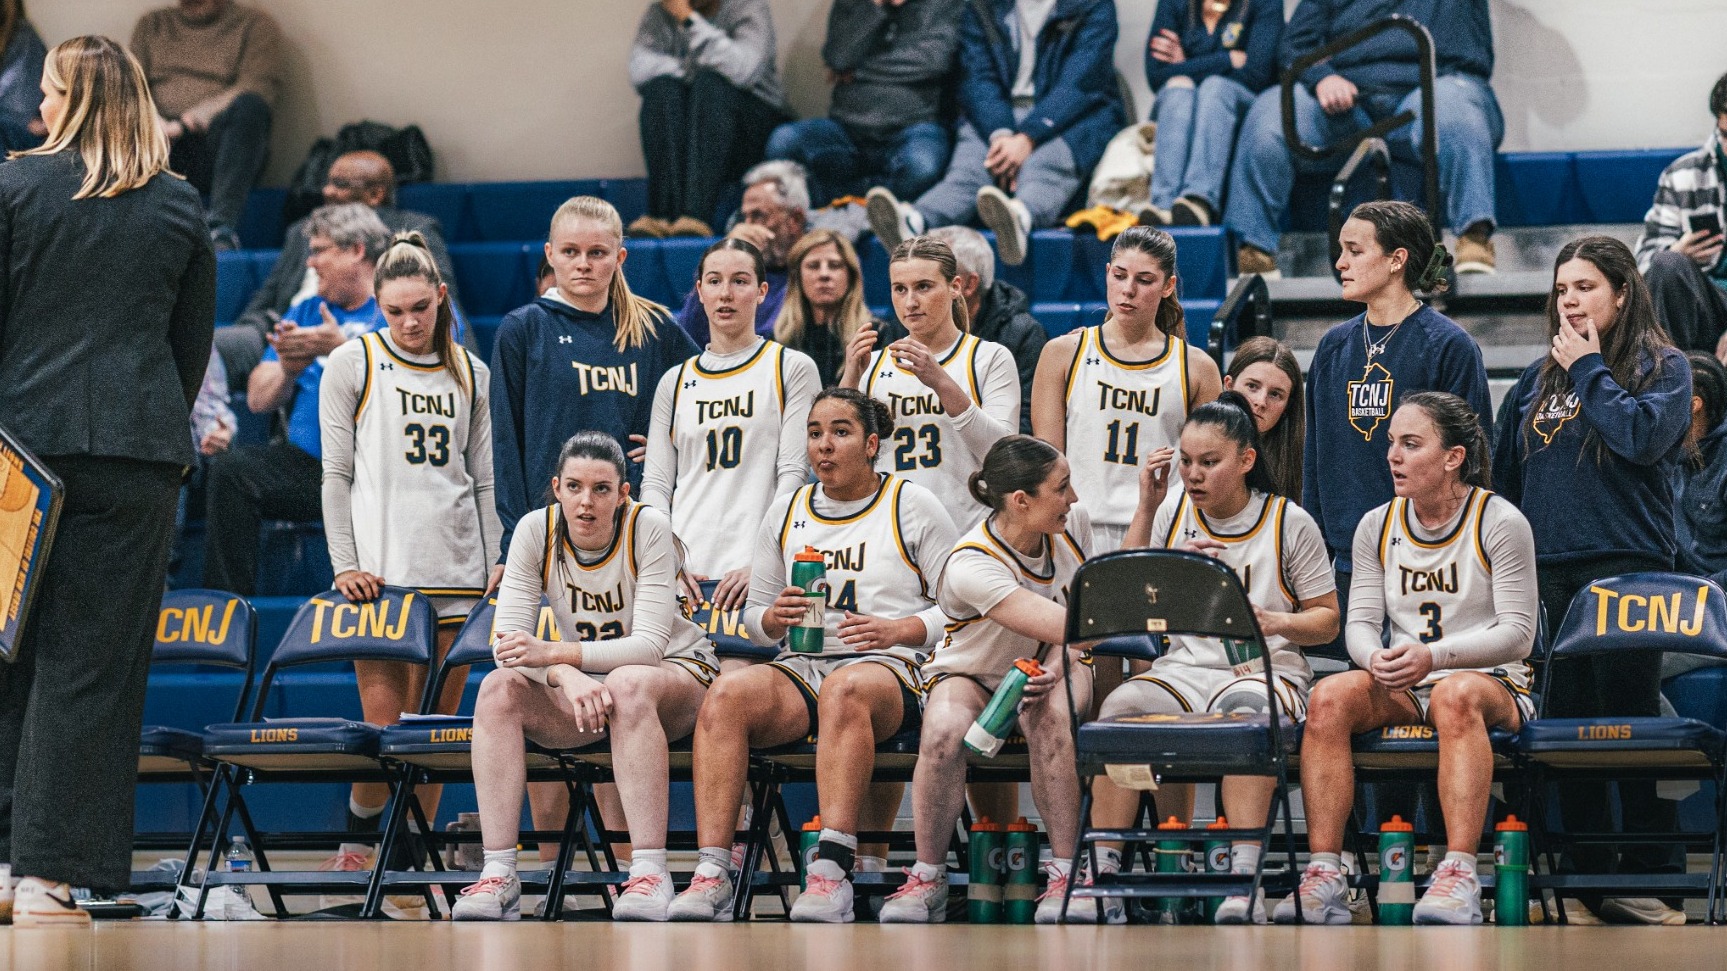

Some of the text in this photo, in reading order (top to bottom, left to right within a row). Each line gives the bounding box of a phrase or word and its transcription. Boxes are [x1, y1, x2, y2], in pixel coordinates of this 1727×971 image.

[571, 360, 638, 397] TCNJ
[1350, 383, 1390, 407] TCNJ
[395, 386, 456, 419] TCNJ
[695, 389, 754, 426] TCNJ
[888, 391, 945, 421] TCNJ
[1097, 379, 1161, 417] TCNJ
[1351, 407, 1386, 417] BASKETBALL
[404, 422, 450, 467] 33
[705, 425, 743, 473] 10
[893, 423, 942, 472] 23
[1103, 418, 1140, 466] 11
[1398, 561, 1459, 596] TCNJ
[566, 582, 625, 614] TCNJ
[1590, 585, 1709, 637] TCNJ
[310, 593, 415, 644] TCNJ
[1419, 601, 1443, 644] 3
[250, 727, 298, 743] LIONS
[430, 727, 473, 743] LIONS
[1381, 725, 1433, 739] LIONS
[1578, 724, 1632, 740] LIONS
[1007, 847, 1025, 871] G
[1209, 847, 1230, 871] G
[1385, 847, 1405, 871] G
